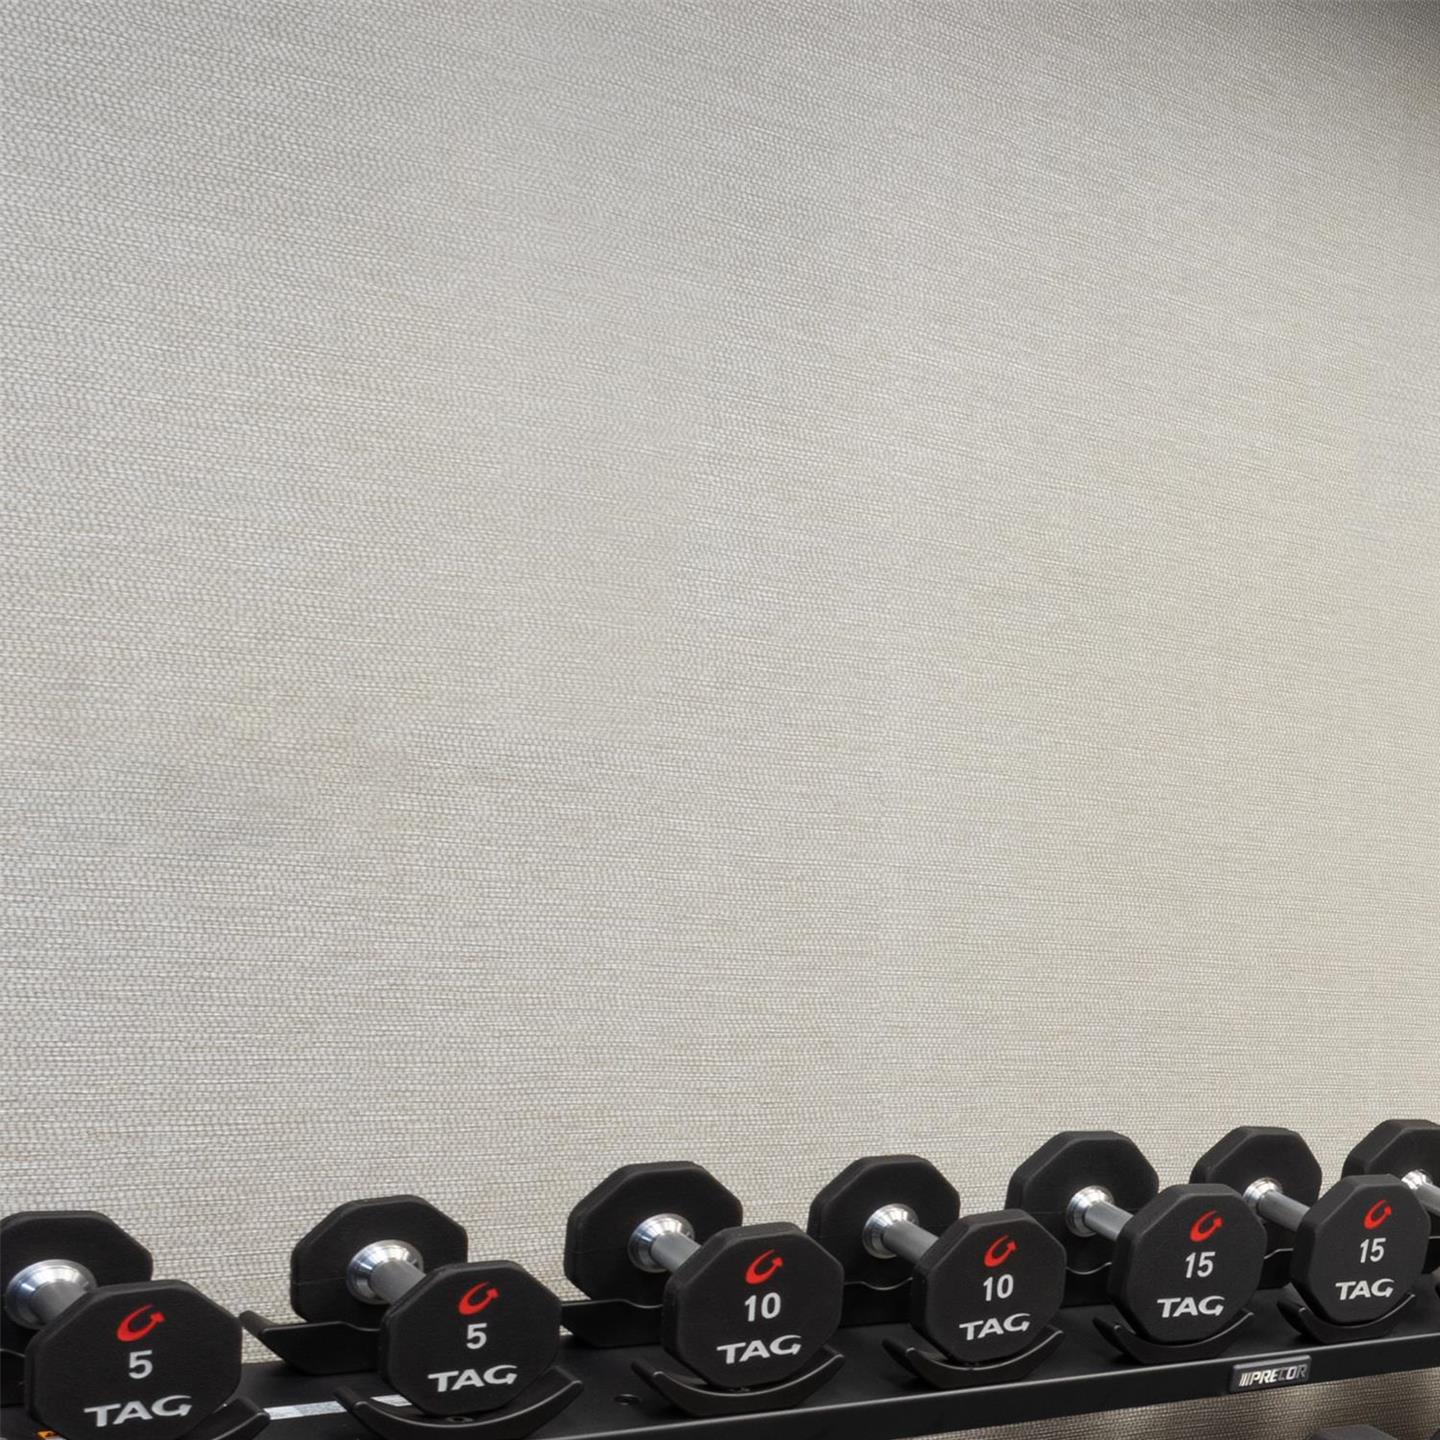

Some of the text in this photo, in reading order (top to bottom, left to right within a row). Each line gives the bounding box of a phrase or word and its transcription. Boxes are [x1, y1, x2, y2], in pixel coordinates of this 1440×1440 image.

[1360, 1237, 1387, 1264] 15
[1185, 1251, 1216, 1279] 15
[983, 1274, 1014, 1302] 10
[1335, 1278, 1394, 1301] TAG
[744, 1292, 781, 1322] 10
[1156, 1295, 1225, 1318] TAG
[466, 1322, 487, 1350] 5
[958, 1312, 1030, 1341] TAG
[716, 1334, 801, 1364] TAG
[129, 1349, 153, 1379] 5
[1246, 1363, 1308, 1386] PRECOR
[427, 1364, 518, 1393] TAG
[84, 1395, 192, 1427] TAG
